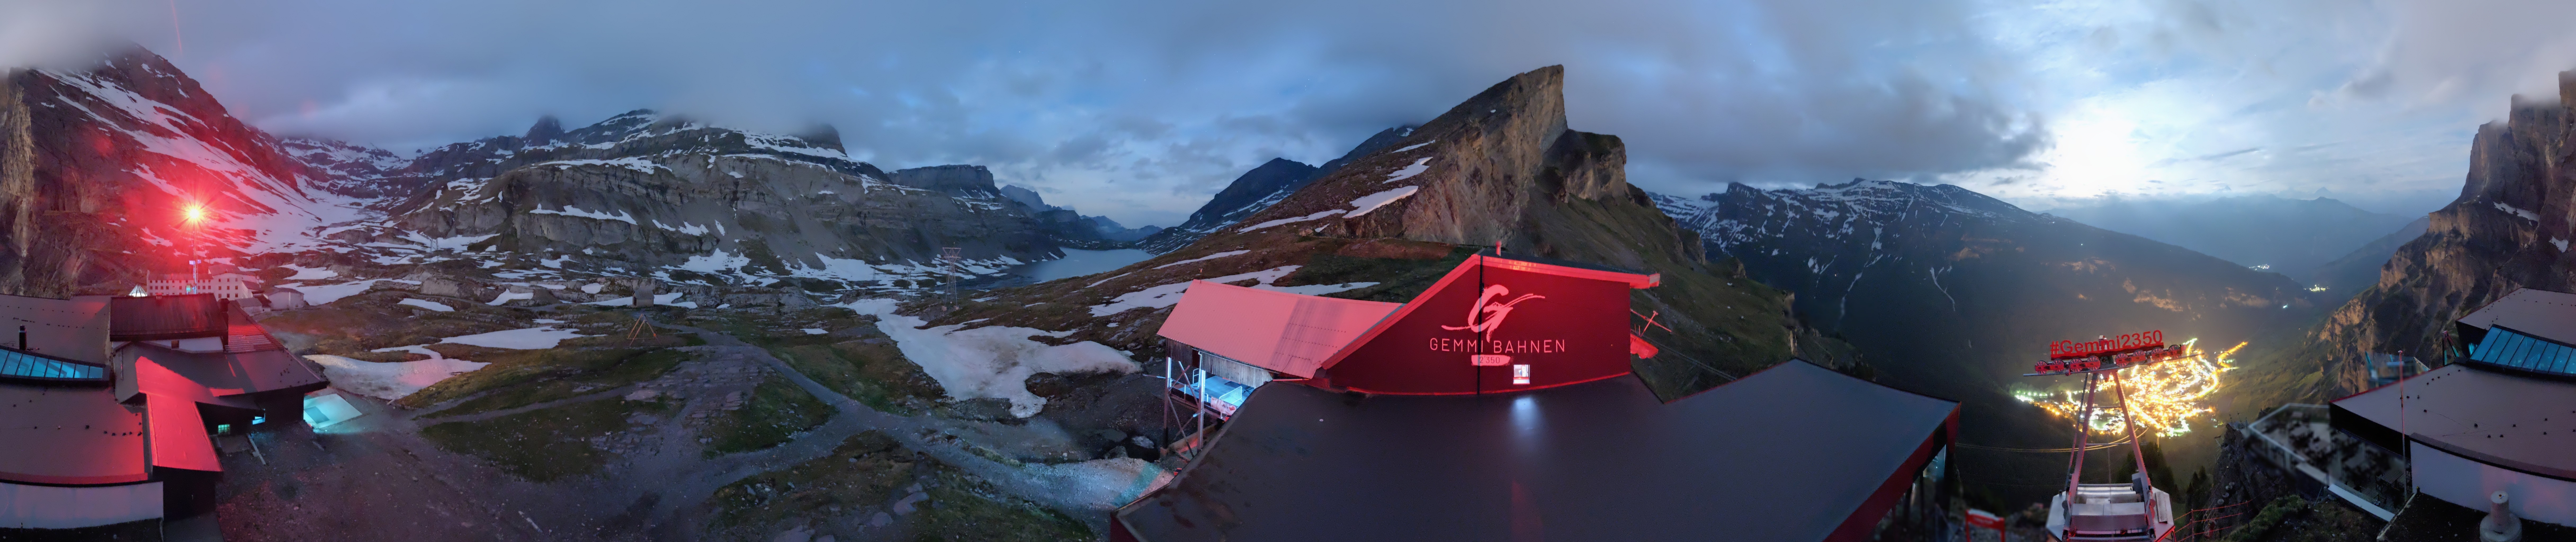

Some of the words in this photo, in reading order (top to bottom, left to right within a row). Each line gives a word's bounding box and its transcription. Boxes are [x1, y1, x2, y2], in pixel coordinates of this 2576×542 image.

[1430, 338, 1483, 353] GEMMI
[1493, 339, 1565, 353] BAHNEN
[2050, 329, 2163, 355] #Gemmi2350
[1479, 355, 1500, 364] 2'350
